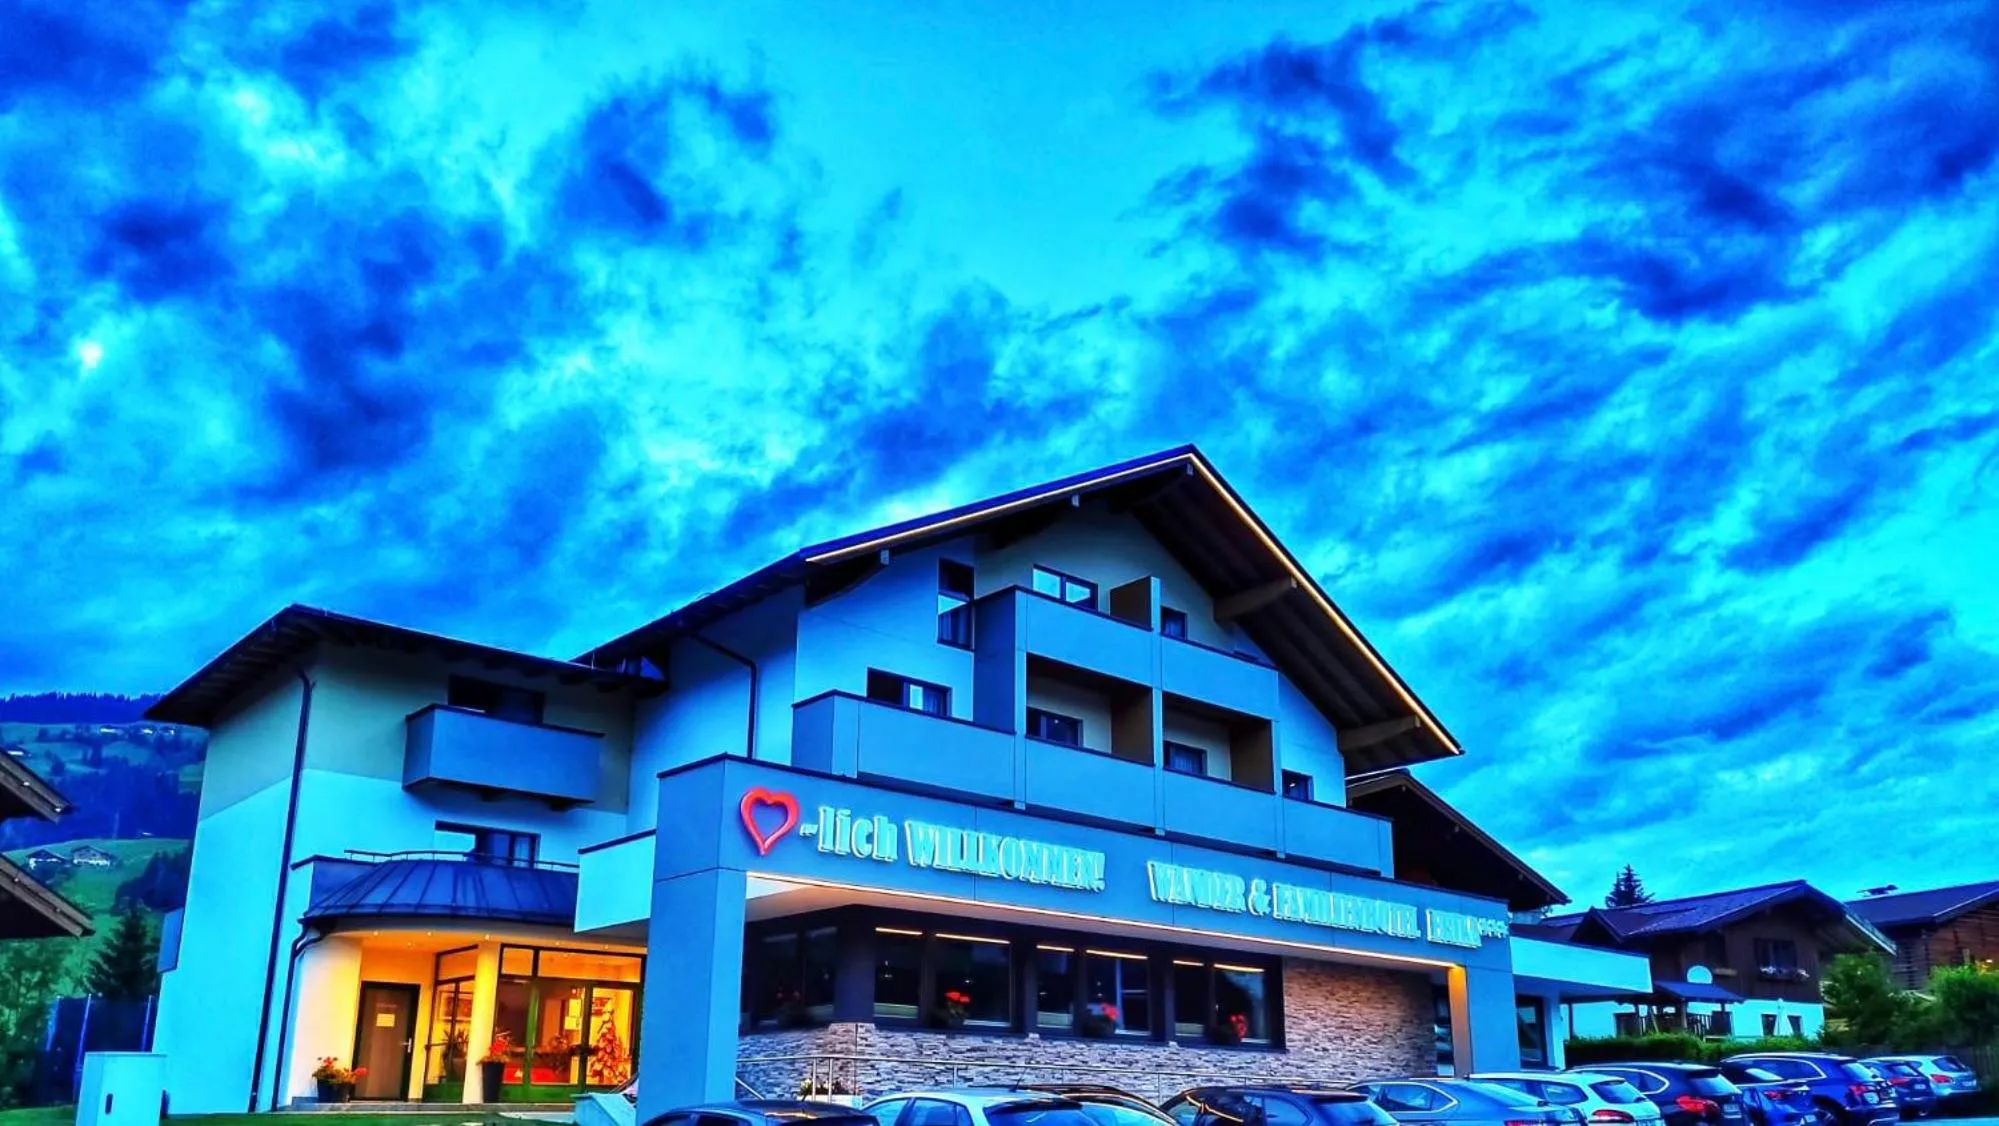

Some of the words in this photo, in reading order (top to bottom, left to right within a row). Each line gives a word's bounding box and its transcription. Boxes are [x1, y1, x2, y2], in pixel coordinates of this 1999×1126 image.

[904, 820, 1105, 893] WILLKOMMEN!
[1147, 861, 1247, 913] WANDER
[1248, 879, 1271, 917] &
[1272, 882, 1421, 939] FAMILIENHOTEL
